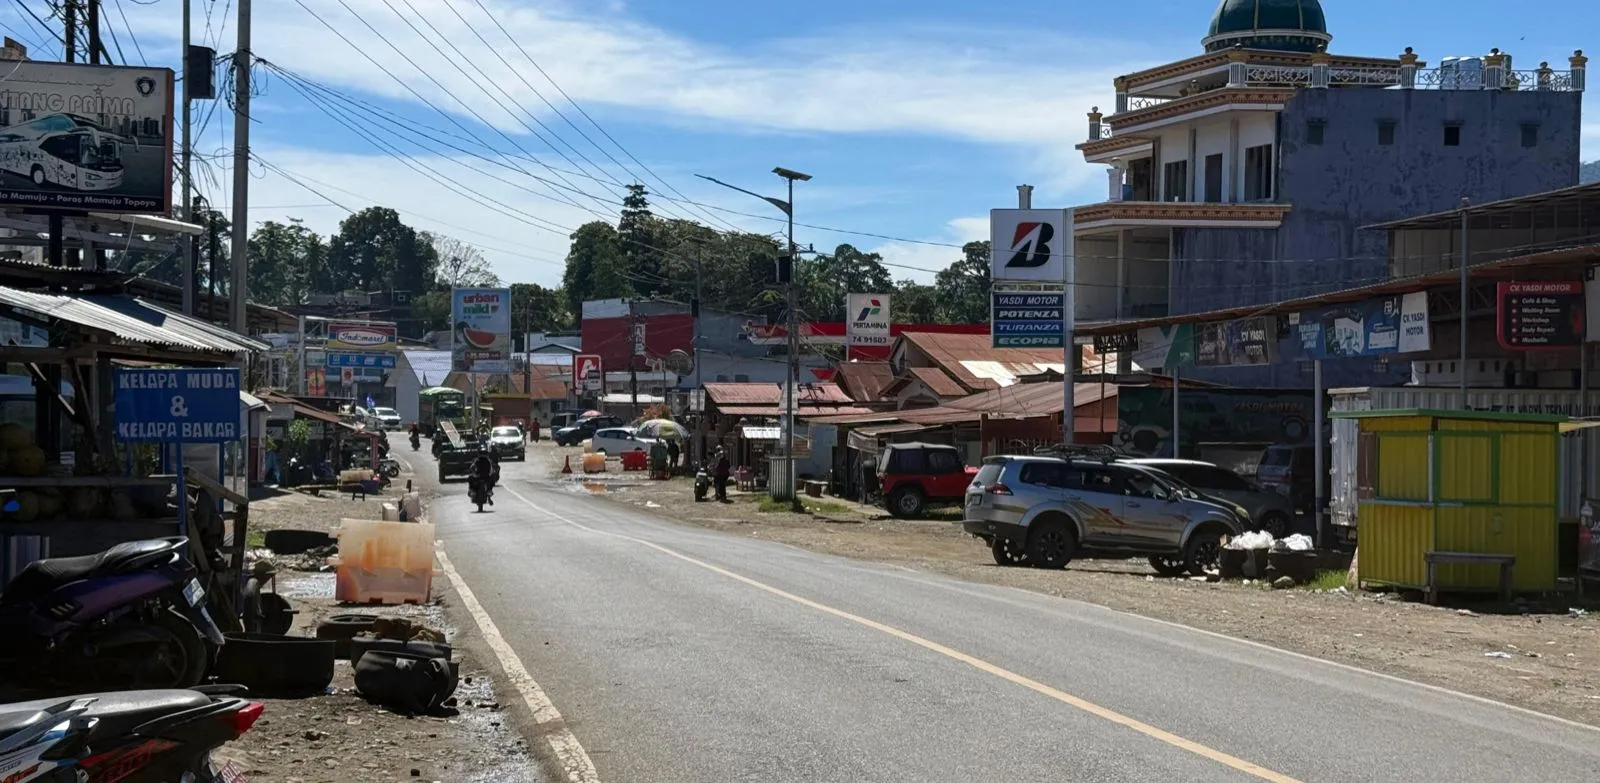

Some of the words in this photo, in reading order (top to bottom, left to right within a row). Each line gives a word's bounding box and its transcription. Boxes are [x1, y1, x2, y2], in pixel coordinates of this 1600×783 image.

[69, 94, 136, 116] PRIMA
[10, 192, 47, 203] Mamuju
[84, 196, 122, 206] Mamuju
[1543, 284, 1571, 292] MOTOR
[463, 293, 499, 304] urban
[999, 296, 1024, 305] YASDI
[1026, 296, 1059, 305] MOTOR
[999, 310, 1060, 318] POTENZA
[1406, 327, 1424, 336] MOTOR
[120, 373, 178, 389] KELAPA
[187, 373, 236, 389] MUDA
[170, 395, 189, 417] &
[119, 422, 177, 438] KELAPA
[182, 422, 235, 438] BAKAR
